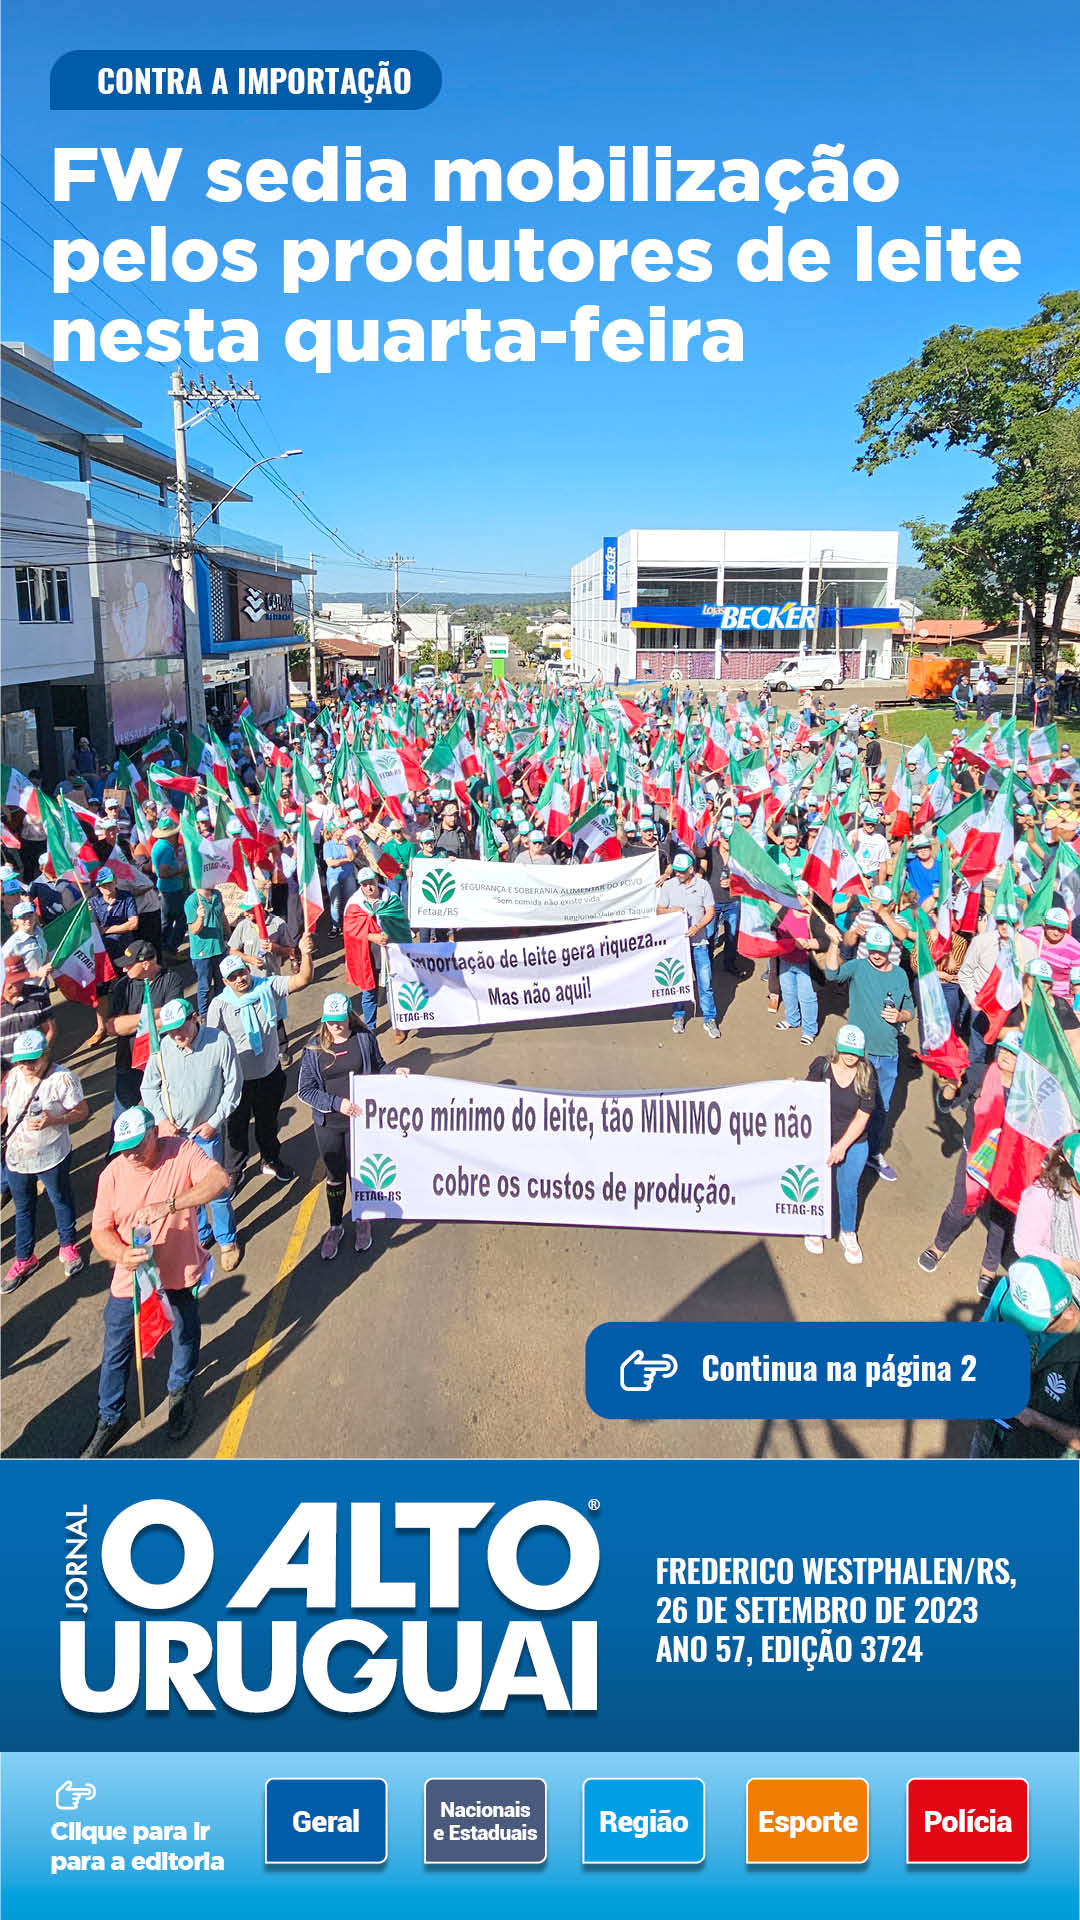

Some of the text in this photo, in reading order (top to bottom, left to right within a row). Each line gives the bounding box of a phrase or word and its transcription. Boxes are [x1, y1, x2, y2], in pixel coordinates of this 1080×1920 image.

[702, 602, 817, 630] Lojas BECKER
[460, 882, 507, 896] SEGURANÇA
[508, 886, 513, 894] E
[514, 886, 559, 895] SOBERANIA
[560, 884, 605, 896] ALIMENTAR
[620, 878, 643, 887] POVO
[514, 898, 541, 906] comida
[544, 898, 559, 906] não
[560, 896, 583, 905] existe
[417, 907, 459, 918] Fetag/RS
[500, 948, 519, 969] de
[522, 944, 558, 968] leite
[561, 943, 596, 967] gera
[599, 933, 668, 959] riqueza...
[487, 975, 592, 1007] Mas não aqui!
[651, 985, 691, 998] FETAG-RS
[396, 1011, 436, 1023] FETAG-RS
[364, 1092, 813, 1145] Preço mínimo do leite, tão MÍNIMO que não
[354, 1190, 402, 1201] FETAG-RS
[432, 1165, 736, 1214] cobre os custos de produção.
[774, 1202, 825, 1217] FETAG-RS
